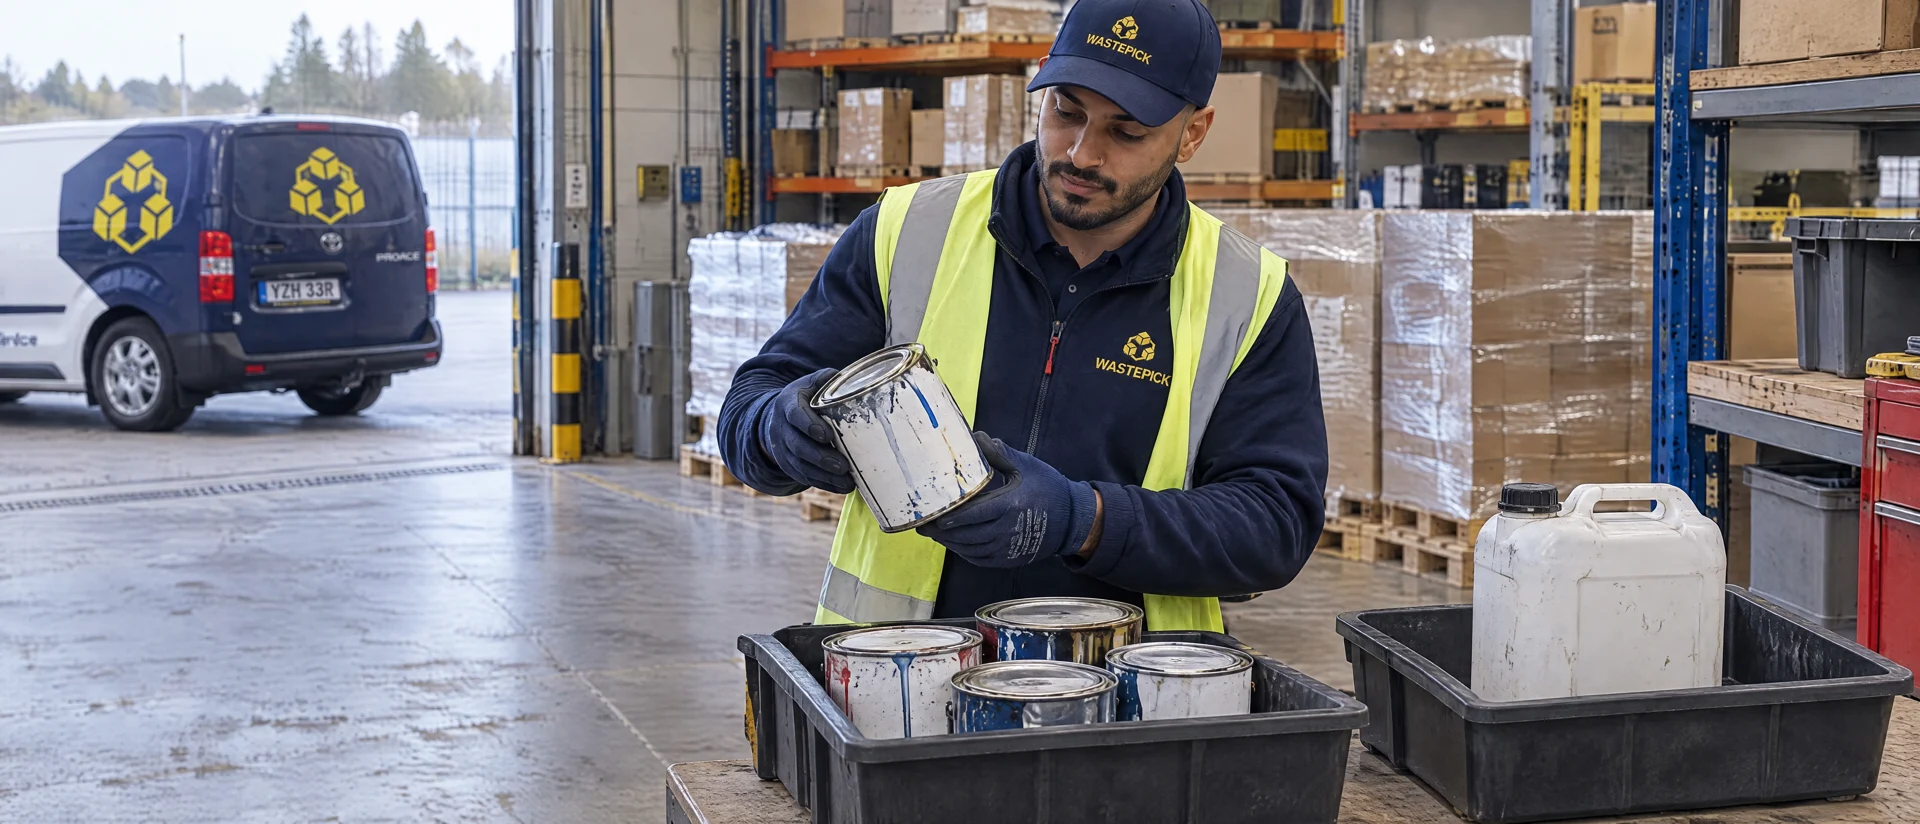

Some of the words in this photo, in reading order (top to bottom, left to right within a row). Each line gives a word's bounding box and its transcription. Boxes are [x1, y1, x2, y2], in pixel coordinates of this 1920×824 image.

[1086, 33, 1152, 65] WASTEPICK
[376, 252, 421, 262] PROACE
[271, 282, 301, 299] YZH
[306, 281, 334, 297] 33R
[1095, 357, 1171, 387] WASTEPICK
